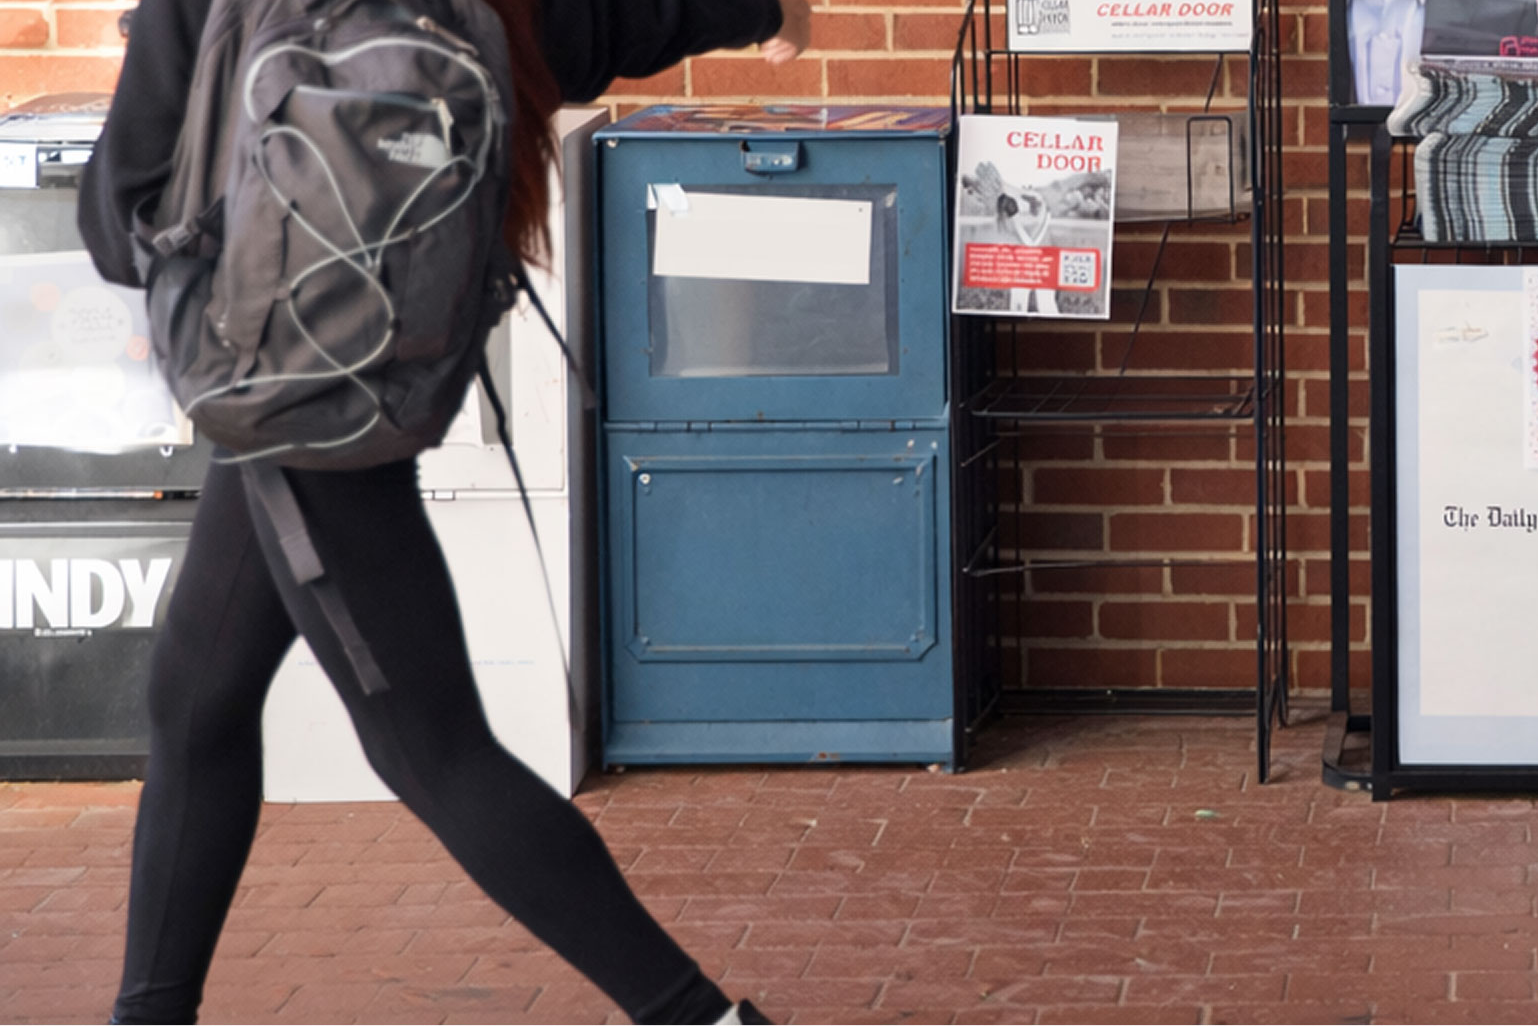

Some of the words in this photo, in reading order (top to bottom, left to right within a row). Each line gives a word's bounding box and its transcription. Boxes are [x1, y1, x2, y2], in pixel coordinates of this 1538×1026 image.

[1097, 2, 1172, 17] CELLAR
[1178, 2, 1235, 17] DOOR
[1006, 131, 1104, 152] CELLAR
[1036, 153, 1102, 173] DOOR
[1443, 505, 1479, 531] The
[1486, 505, 1538, 533] Daily
[0, 557, 172, 629] INDY
